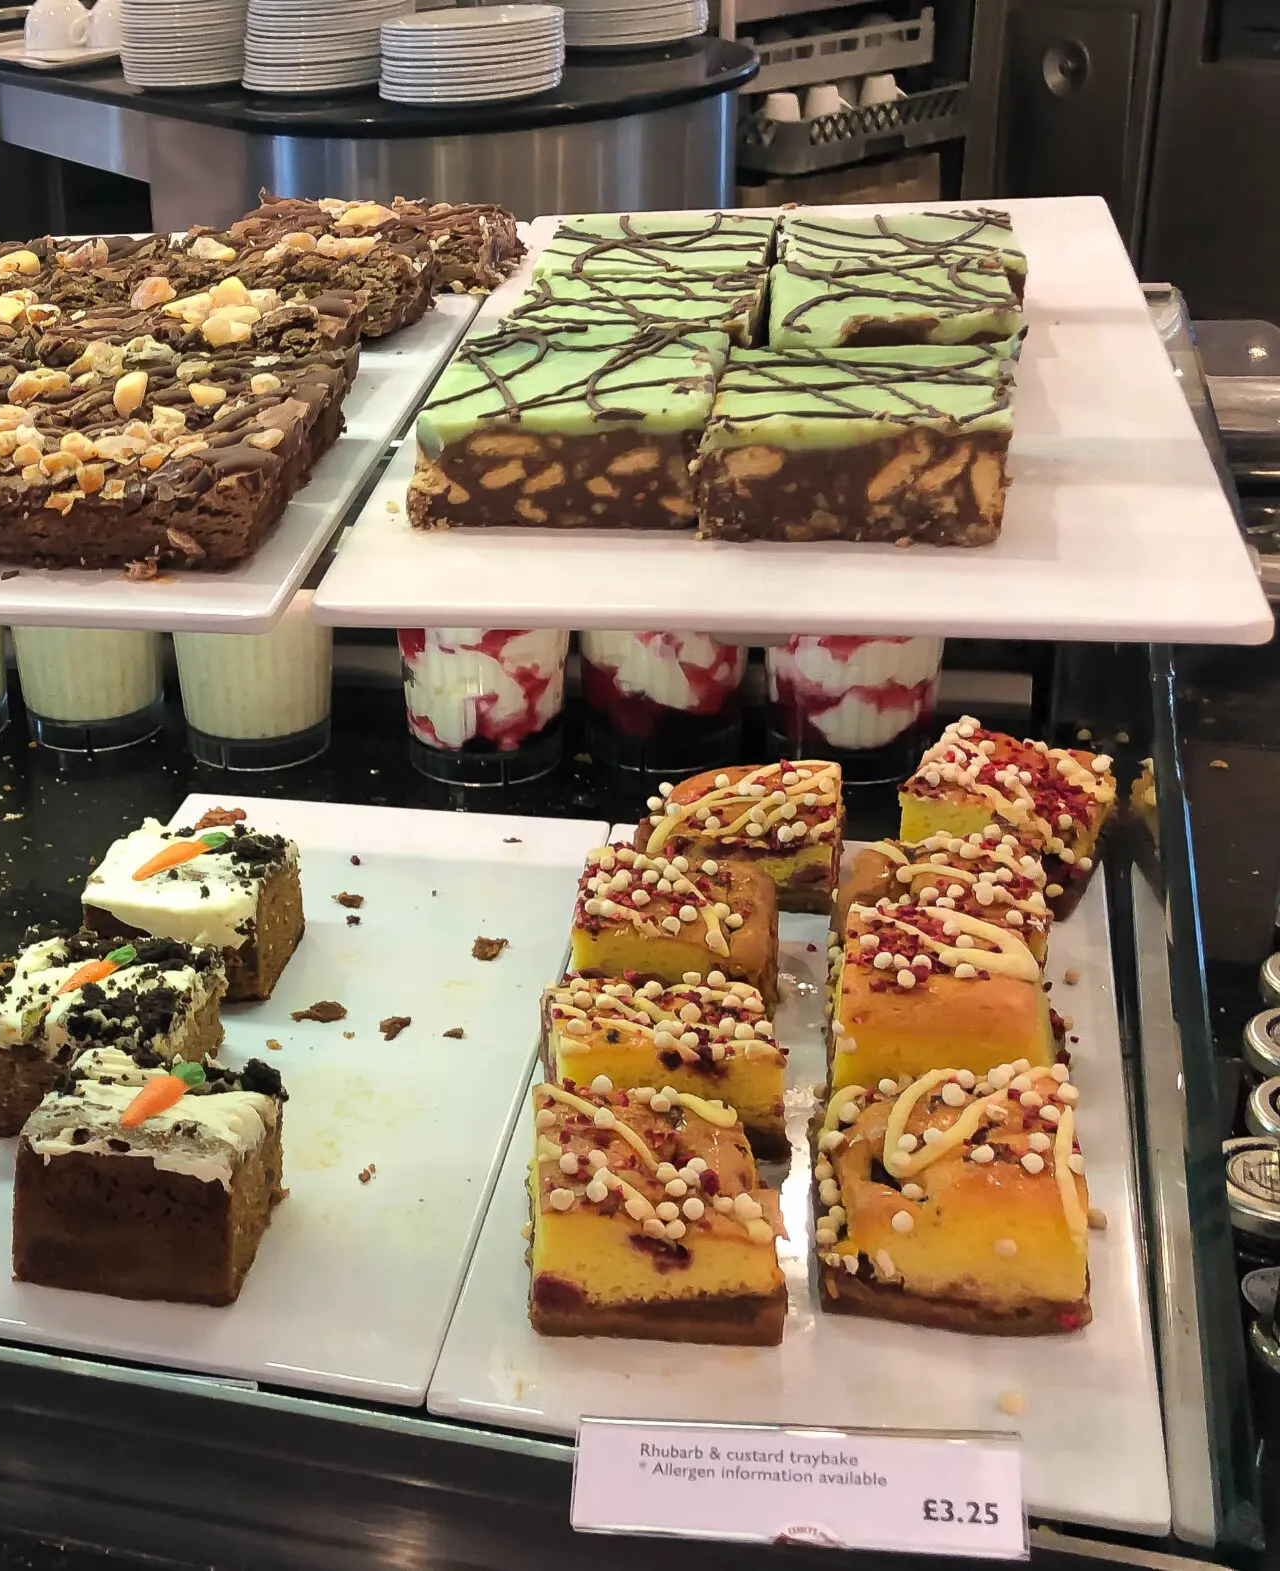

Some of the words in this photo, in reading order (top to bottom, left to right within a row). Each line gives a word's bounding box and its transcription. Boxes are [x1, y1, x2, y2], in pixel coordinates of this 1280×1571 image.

[639, 1443, 704, 1460] Rhubarb
[709, 1446, 721, 1461] &
[726, 1449, 784, 1464] custard
[789, 1450, 859, 1469] traybake
[651, 1462, 716, 1481] Allergen
[720, 1465, 814, 1483] information
[818, 1470, 888, 1487] available
[922, 1498, 999, 1525] £3.25
